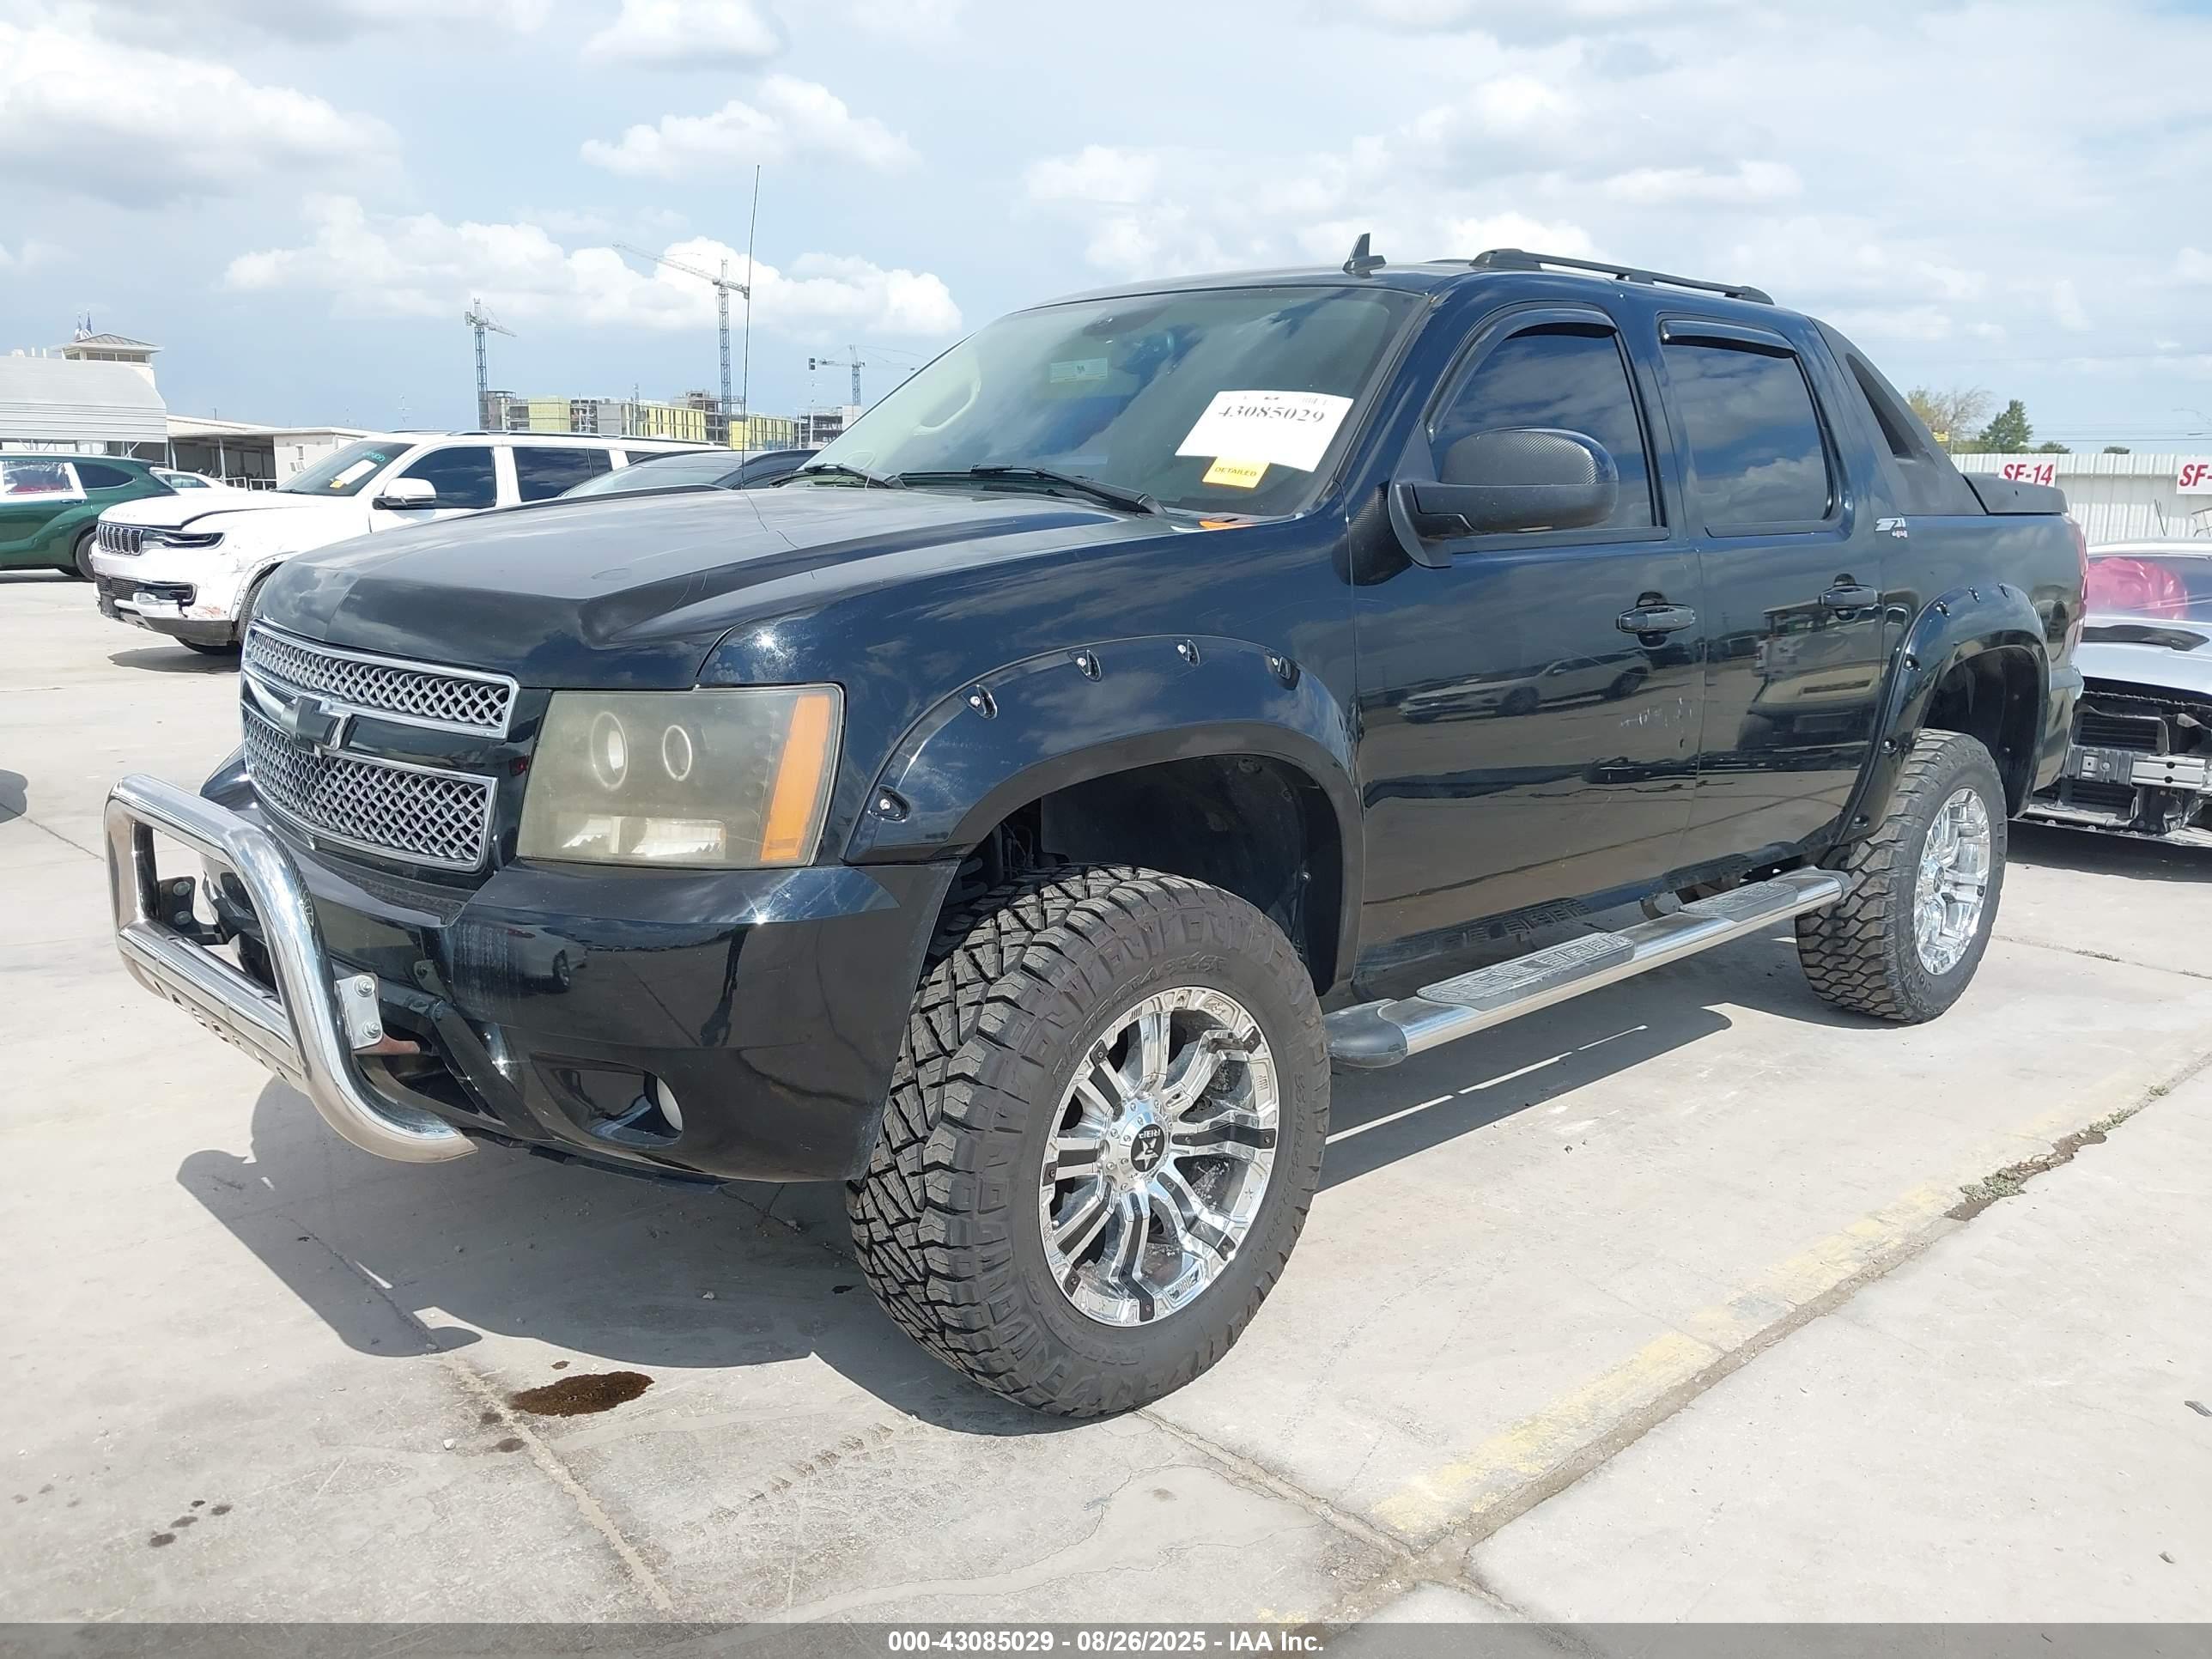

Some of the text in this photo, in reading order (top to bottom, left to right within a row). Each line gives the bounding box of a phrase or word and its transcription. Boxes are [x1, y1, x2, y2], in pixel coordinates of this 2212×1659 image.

[1218, 405, 1325, 423] 43085029
[1214, 466, 1258, 477] DETAILED
[2004, 464, 2054, 486] SF-14
